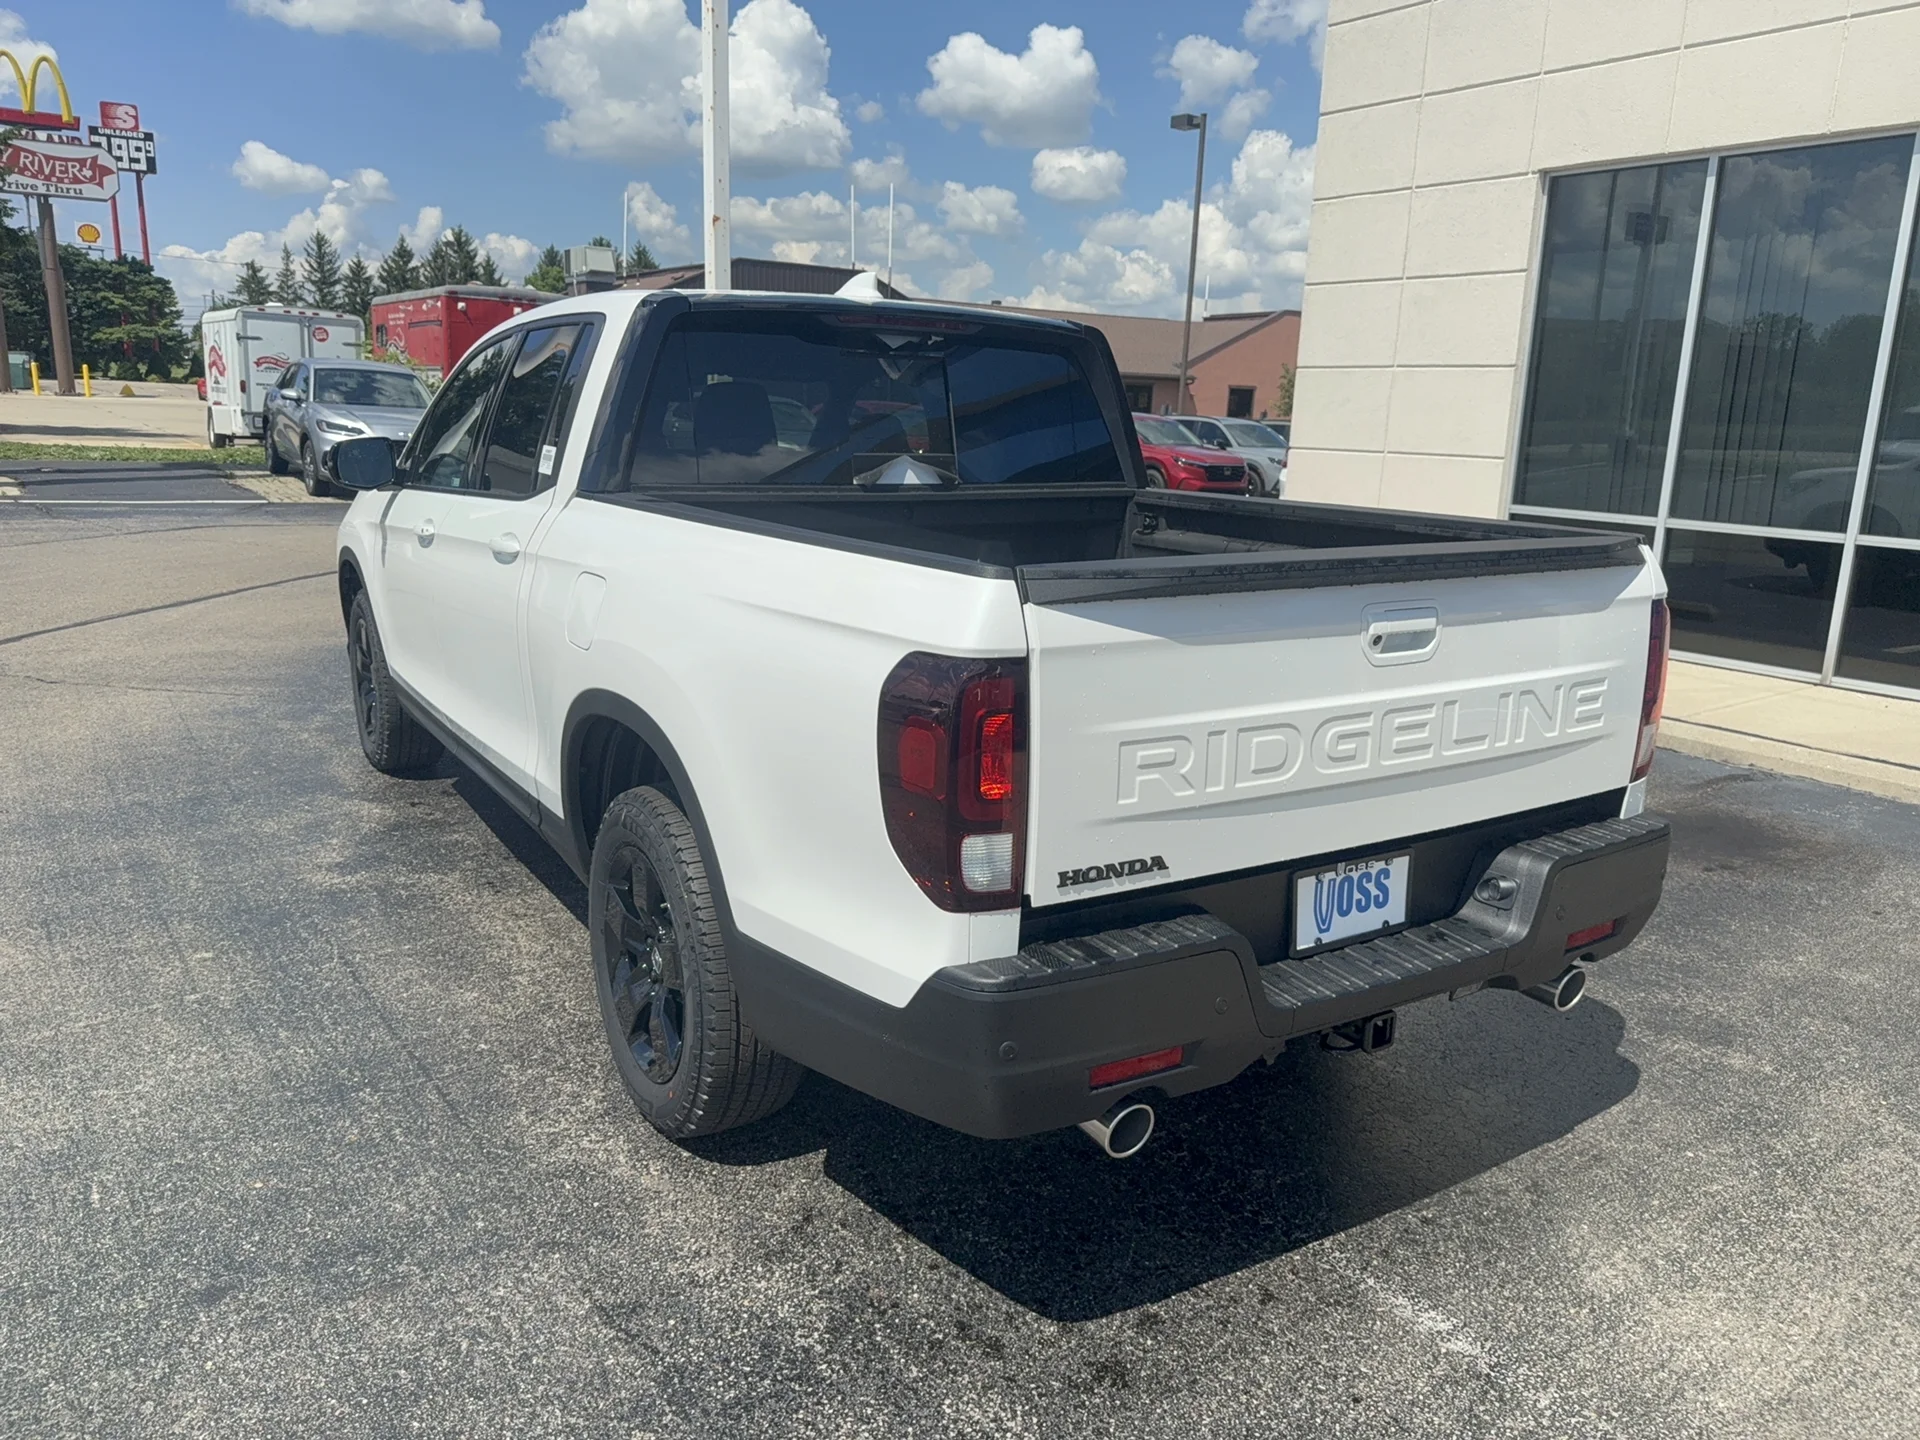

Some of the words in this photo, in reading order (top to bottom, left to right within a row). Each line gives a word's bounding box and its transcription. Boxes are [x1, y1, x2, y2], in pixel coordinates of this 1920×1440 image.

[98, 127, 145, 138] UNLEADED
[42, 182, 84, 195] Thru
[1117, 676, 1609, 805] RIDGELINE
[1056, 855, 1170, 889] HONDA
[1313, 867, 1391, 935] VOSS
